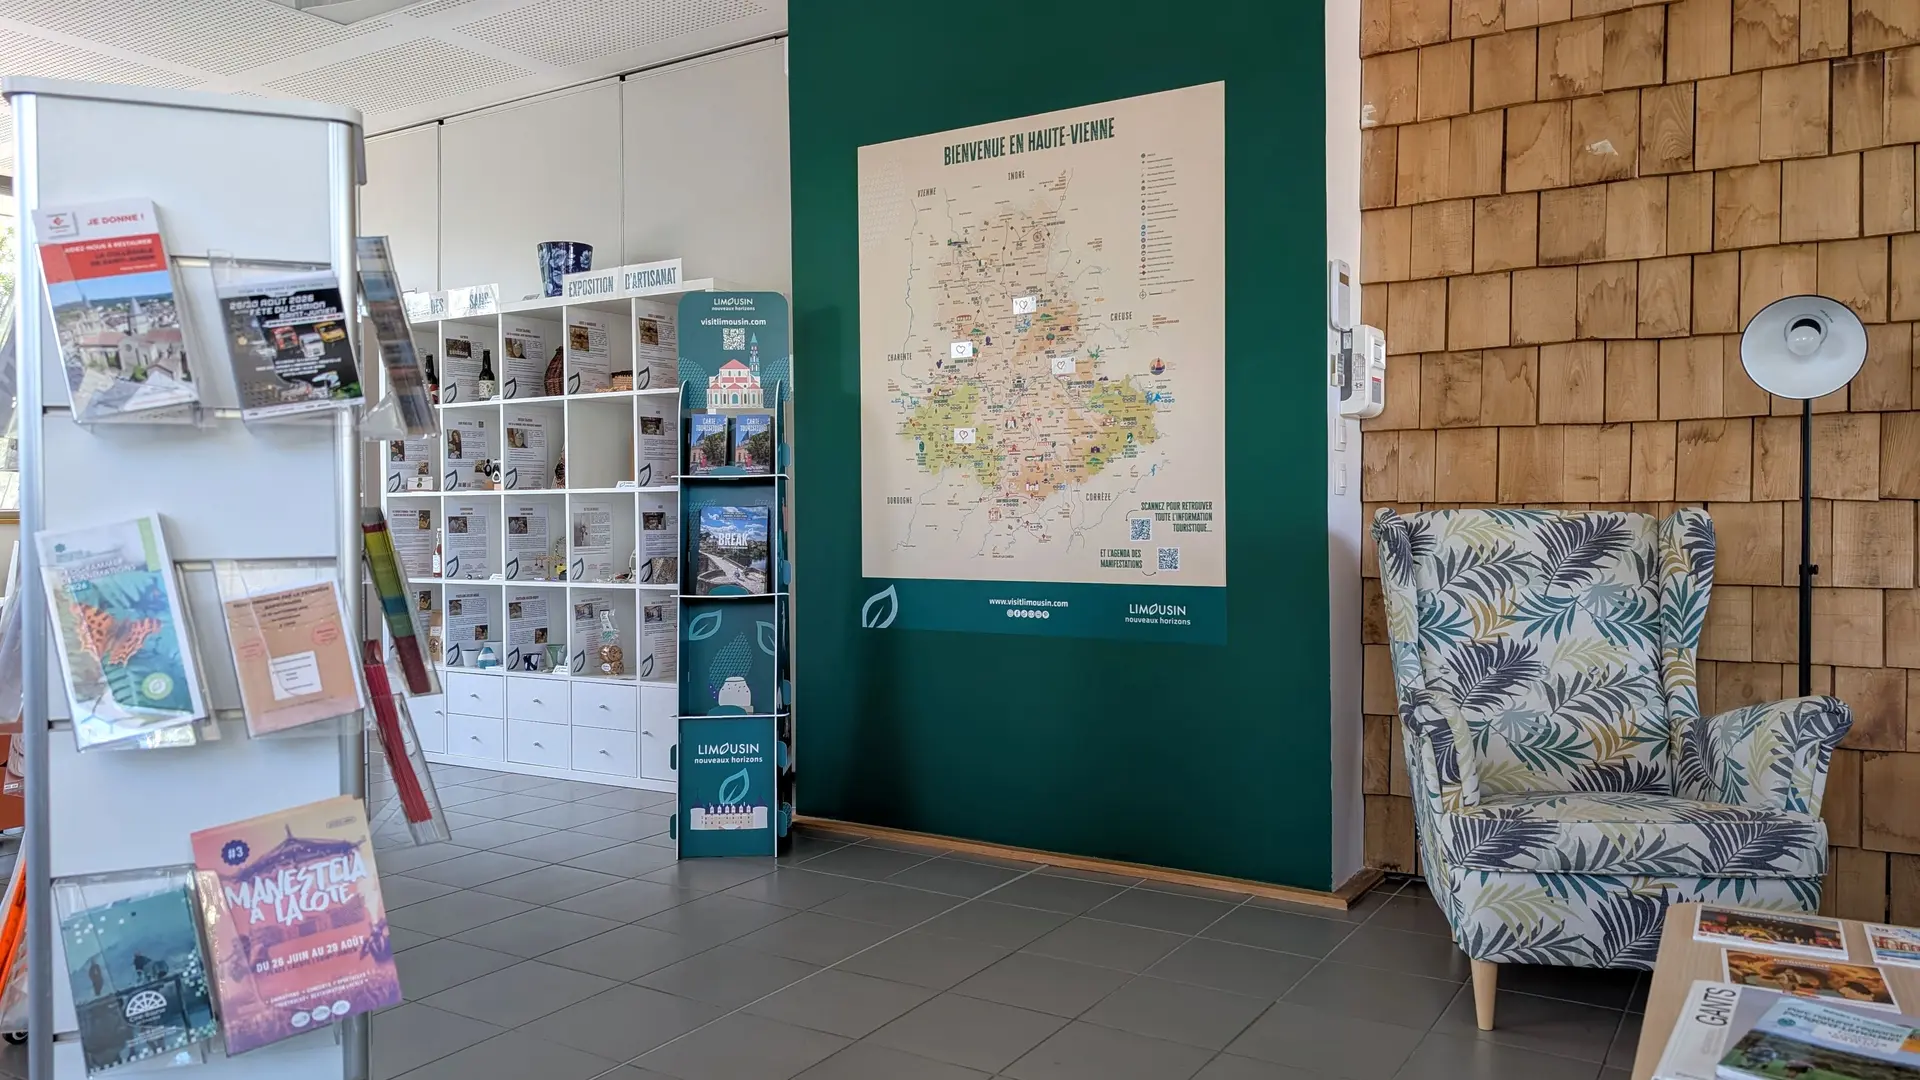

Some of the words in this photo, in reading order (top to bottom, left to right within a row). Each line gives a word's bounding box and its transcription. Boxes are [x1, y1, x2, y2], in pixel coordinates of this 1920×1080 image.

[944, 137, 1006, 166] BIENVENUE
[1009, 133, 1024, 154] EN
[1028, 117, 1115, 152] HAUTE-VIENNE
[1008, 170, 1025, 180] INDRE
[917, 187, 936, 198] VIENNE
[102, 214, 138, 224] DONNE
[568, 276, 614, 298] EXPOSITION
[625, 267, 676, 290] D'ARTISANAT
[274, 304, 288, 314] DU
[289, 301, 326, 311] CAMION
[1110, 311, 1132, 321] CREUSE
[887, 352, 912, 361] CHARENTE
[1086, 492, 1111, 501] CORRÈZE
[1141, 502, 1164, 510] SCANNEZ
[1166, 502, 1180, 510] POUR
[1182, 502, 1213, 510] RETROUVER
[1155, 513, 1171, 521] TOUTE
[1172, 513, 1213, 522] L'INFORMATION
[718, 532, 748, 546] BREAK
[1100, 549, 1106, 558] ET
[1108, 549, 1130, 558] L'AGENDA
[1132, 549, 1141, 558] DES
[1100, 560, 1142, 569] MANIFESTATIONS
[989, 598, 1068, 608] www.visitlimousin.com
[1129, 603, 1186, 616] LIMOUSIN
[1125, 616, 1158, 624] nouveaux
[1160, 617, 1191, 626] horizons
[698, 742, 760, 755] LIMOUSIN
[227, 846, 244, 860] #3
[256, 961, 269, 973] DU
[286, 952, 309, 964] JUIN
[312, 947, 324, 958] AU
[341, 935, 364, 950] AOÛT
[1695, 988, 1736, 1026] GANTS
